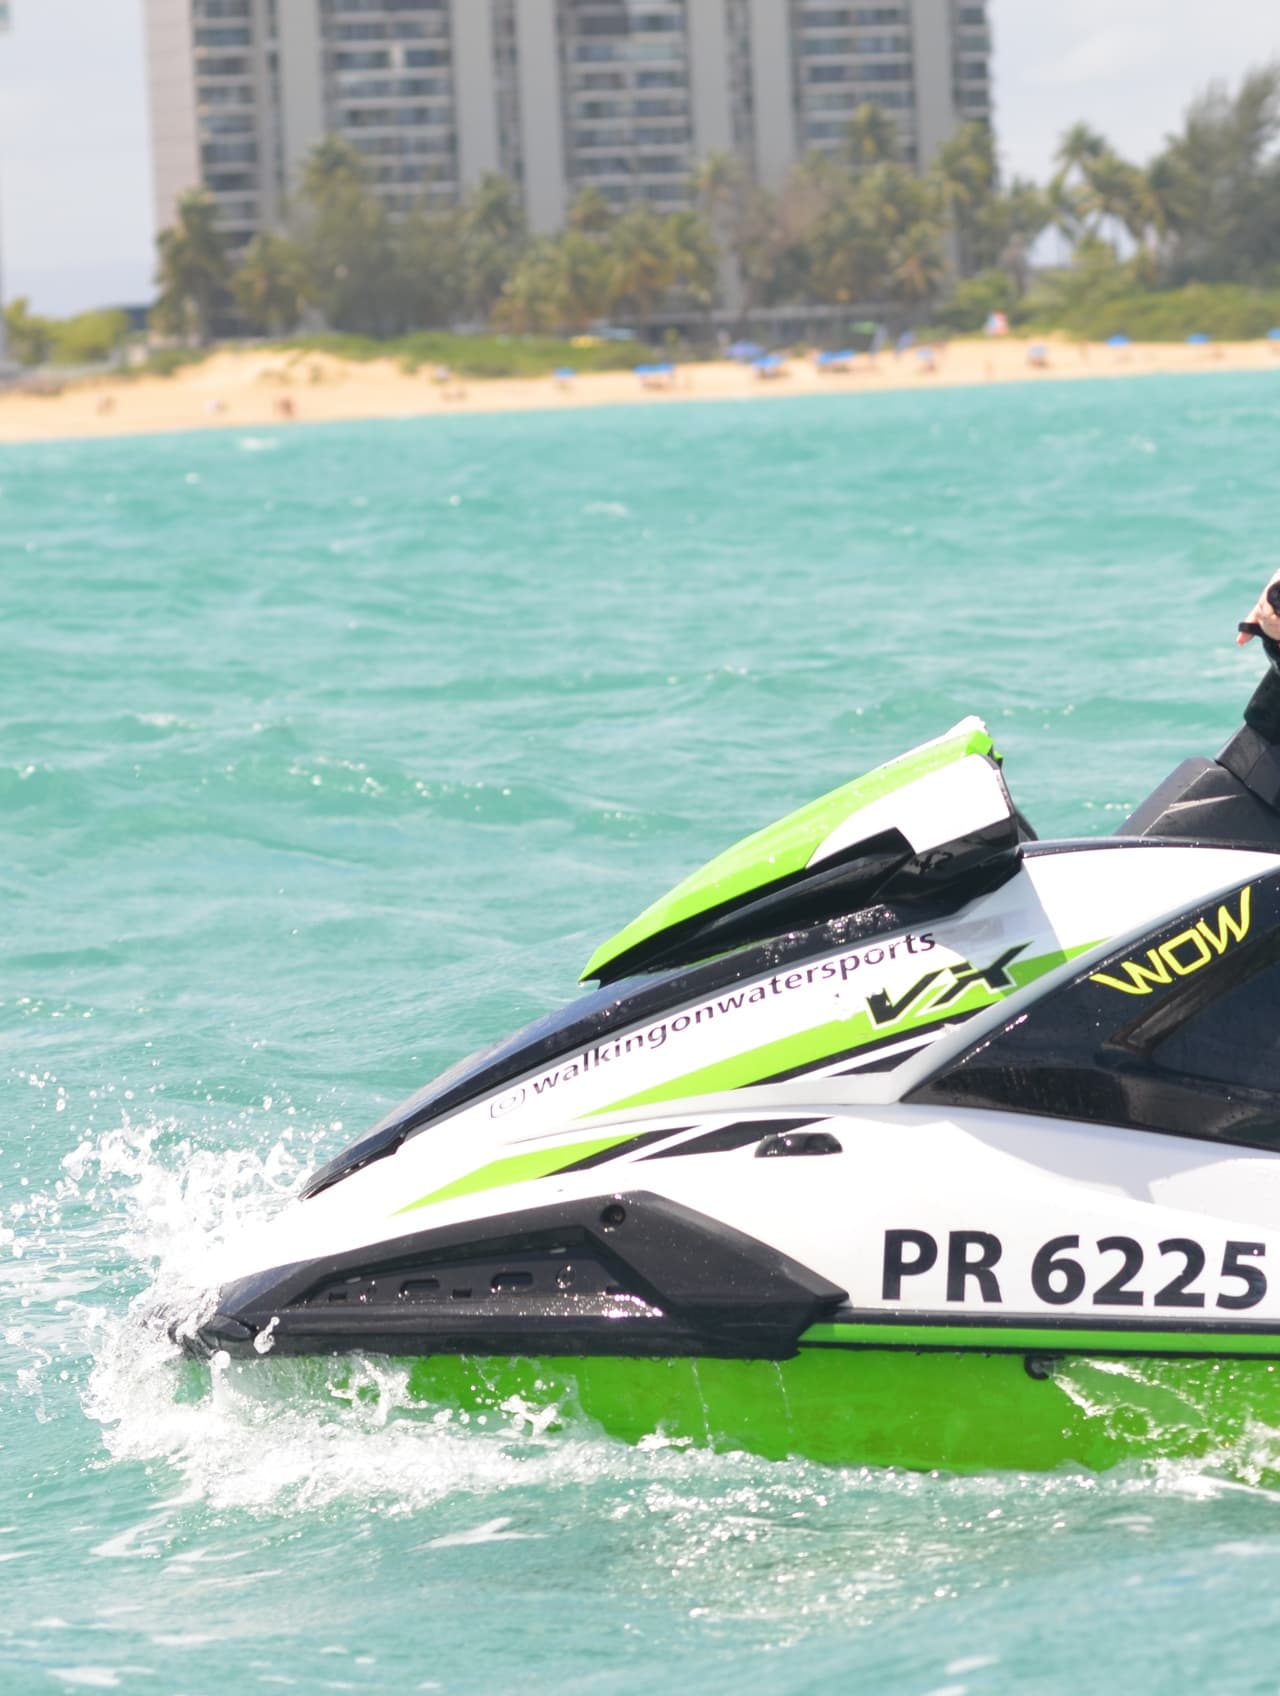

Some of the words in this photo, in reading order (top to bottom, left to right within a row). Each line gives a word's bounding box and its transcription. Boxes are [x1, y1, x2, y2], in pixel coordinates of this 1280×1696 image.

[865, 940, 1035, 1028] VX
[1088, 886, 1252, 995] WOW
[532, 931, 936, 1095] walkingonwatersports
[881, 1228, 1003, 1303] PR
[1030, 1234, 1268, 1310] 6225
